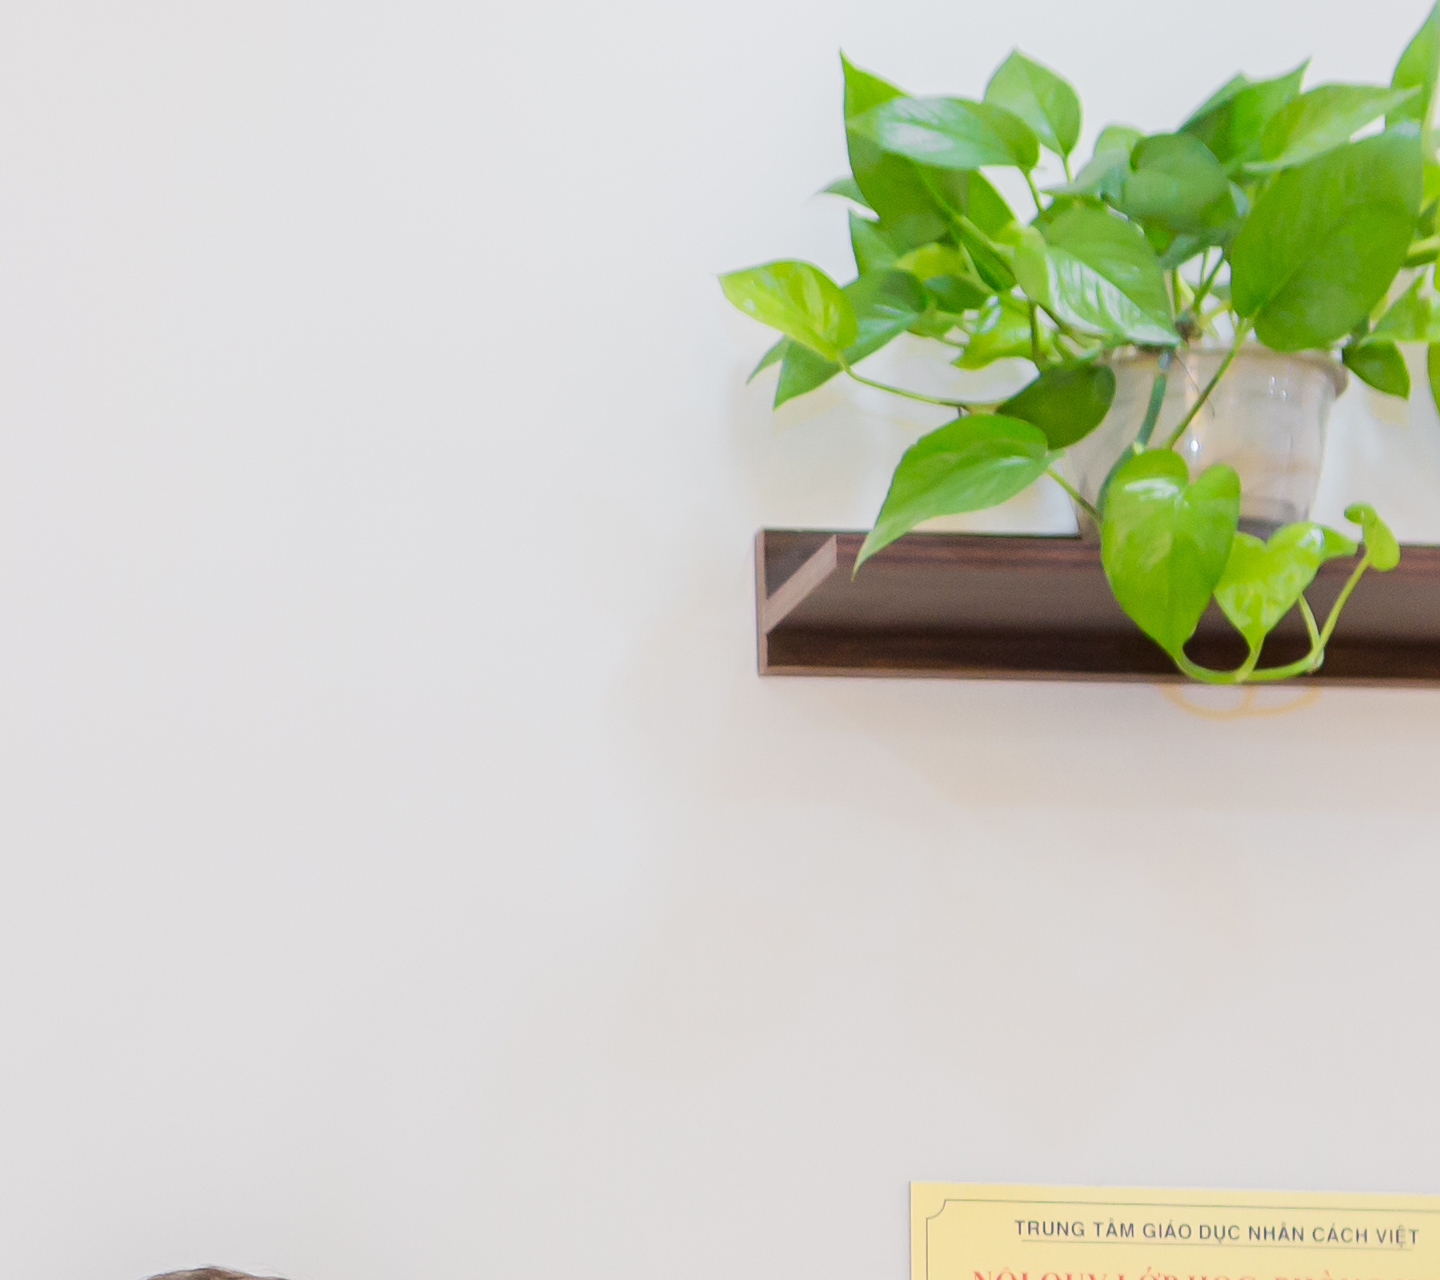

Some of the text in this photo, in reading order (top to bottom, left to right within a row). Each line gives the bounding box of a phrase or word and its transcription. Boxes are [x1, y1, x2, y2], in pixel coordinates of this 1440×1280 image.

[1014, 1218, 1419, 1248] TRUNG TÂM GIÁO DỤC NHÂN CÁCH VIỆT
